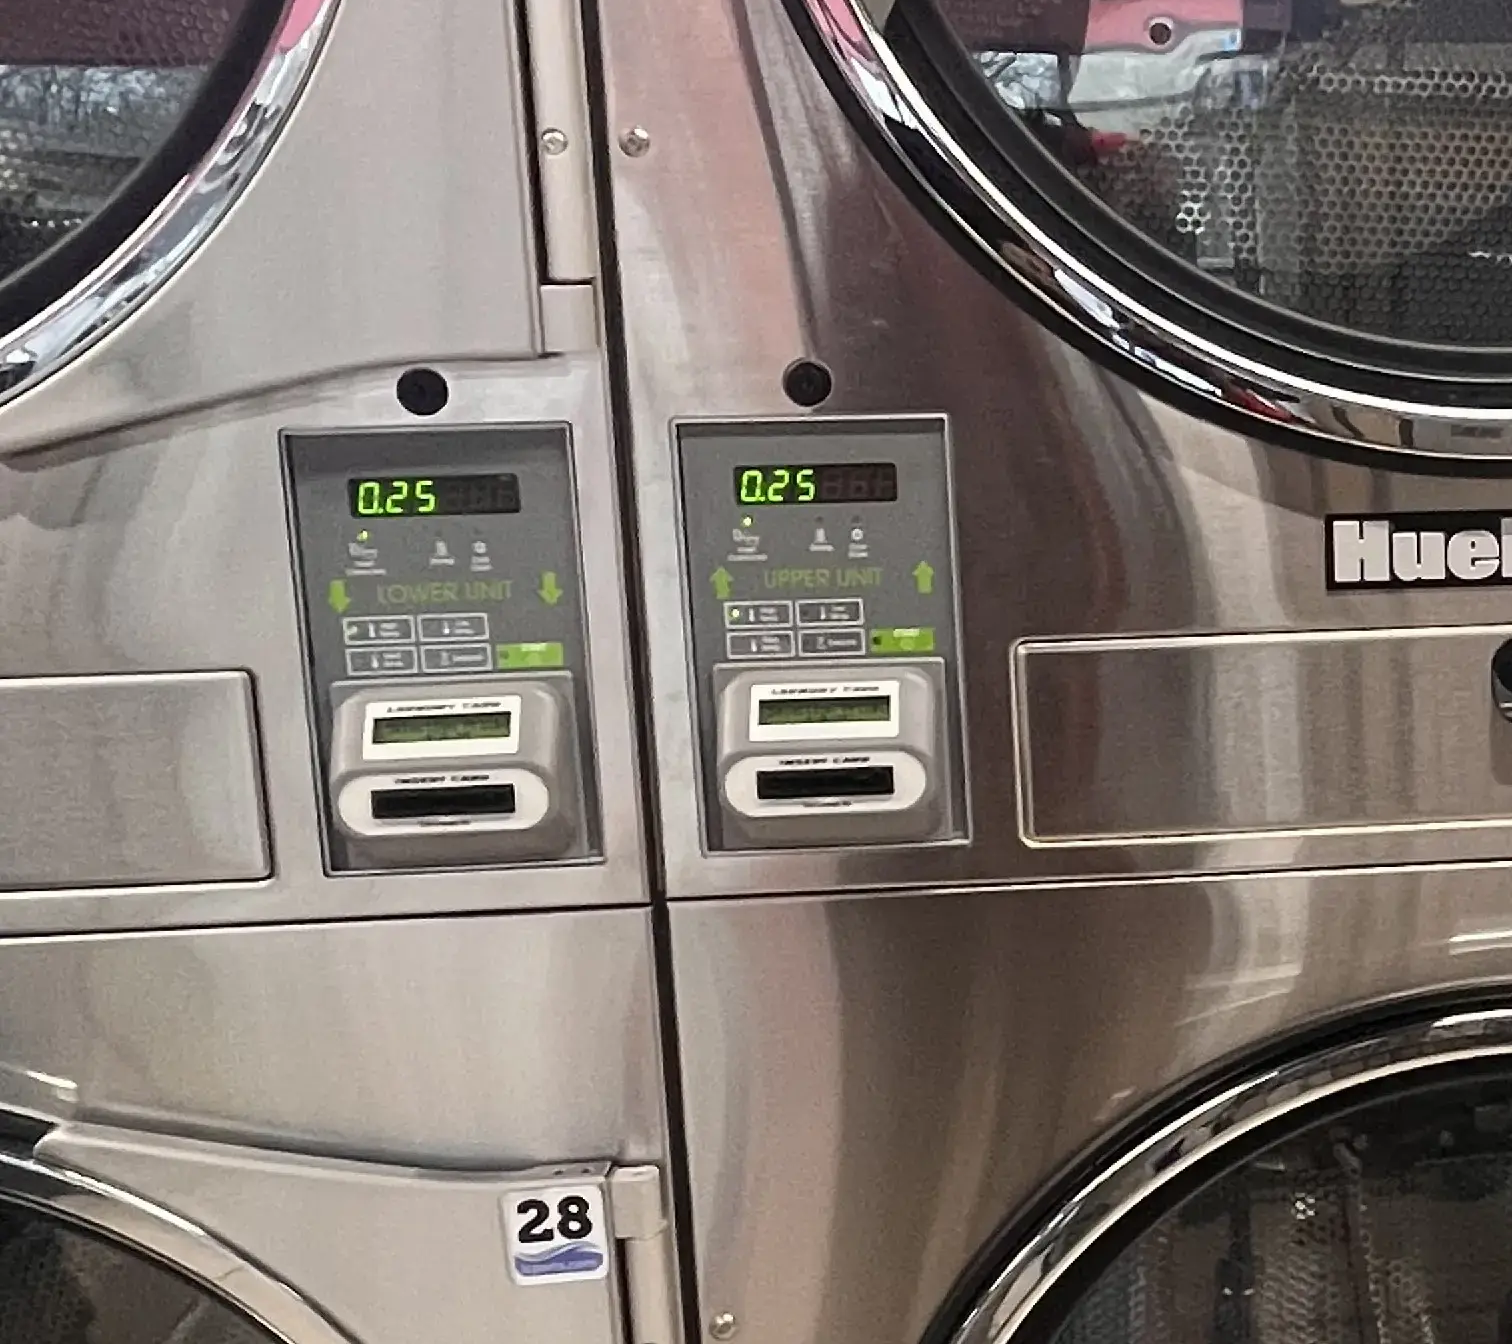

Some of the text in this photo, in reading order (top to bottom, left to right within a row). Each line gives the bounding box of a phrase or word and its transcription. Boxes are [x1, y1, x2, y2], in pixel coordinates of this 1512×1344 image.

[357, 480, 436, 515] 0.25
[740, 468, 816, 502] 0.25
[377, 579, 513, 605] LOWER UNIT
[764, 566, 885, 590] UPPER UNIT
[516, 1195, 593, 1243] 28
